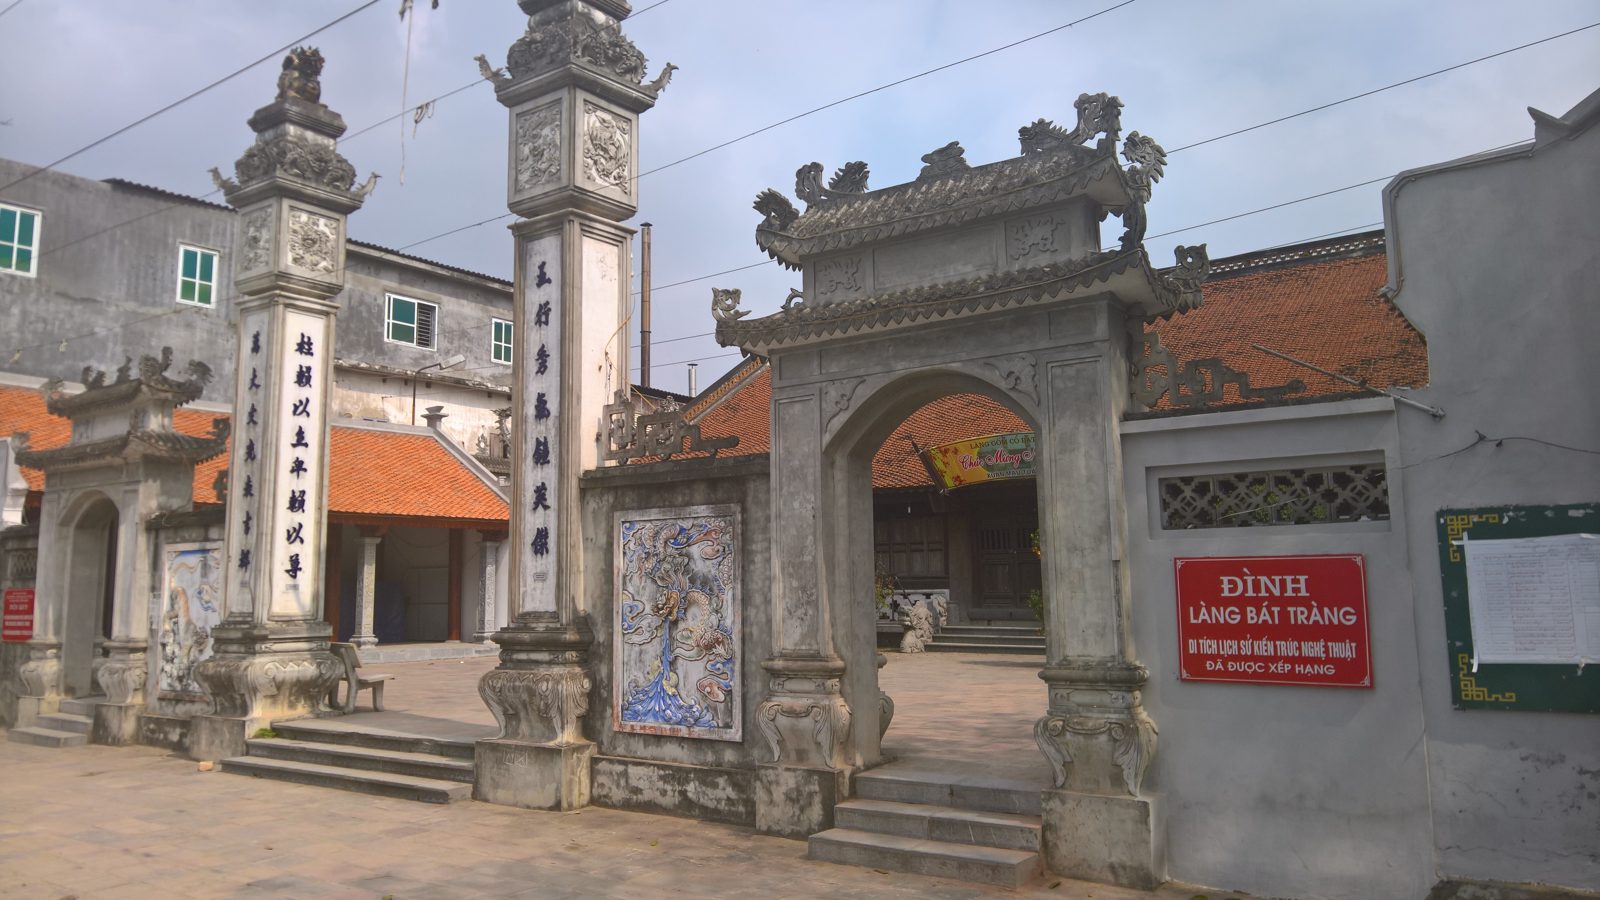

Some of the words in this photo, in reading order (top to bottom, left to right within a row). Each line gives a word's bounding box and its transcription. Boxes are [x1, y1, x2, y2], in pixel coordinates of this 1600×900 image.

[1219, 568, 1310, 597] ĐÌNH
[1189, 601, 1241, 625] LÀNG
[1247, 601, 1280, 625] BÁT
[1287, 601, 1357, 625] TRÀNG
[1188, 639, 1197, 654] DI
[1199, 636, 1217, 655] TÍCH
[1219, 639, 1238, 658] LỊCH
[1240, 634, 1252, 656] SỬ
[1254, 635, 1274, 656] KIẾN
[1276, 637, 1299, 657] TRÚC
[1301, 638, 1325, 660] NGHỆ
[1327, 639, 1357, 661] THUẬT
[1205, 659, 1224, 672] ĐÃ
[1228, 661, 1265, 674] ĐƯỢC
[1268, 659, 1292, 674] XẾP
[1295, 663, 1336, 677] HẠNG
